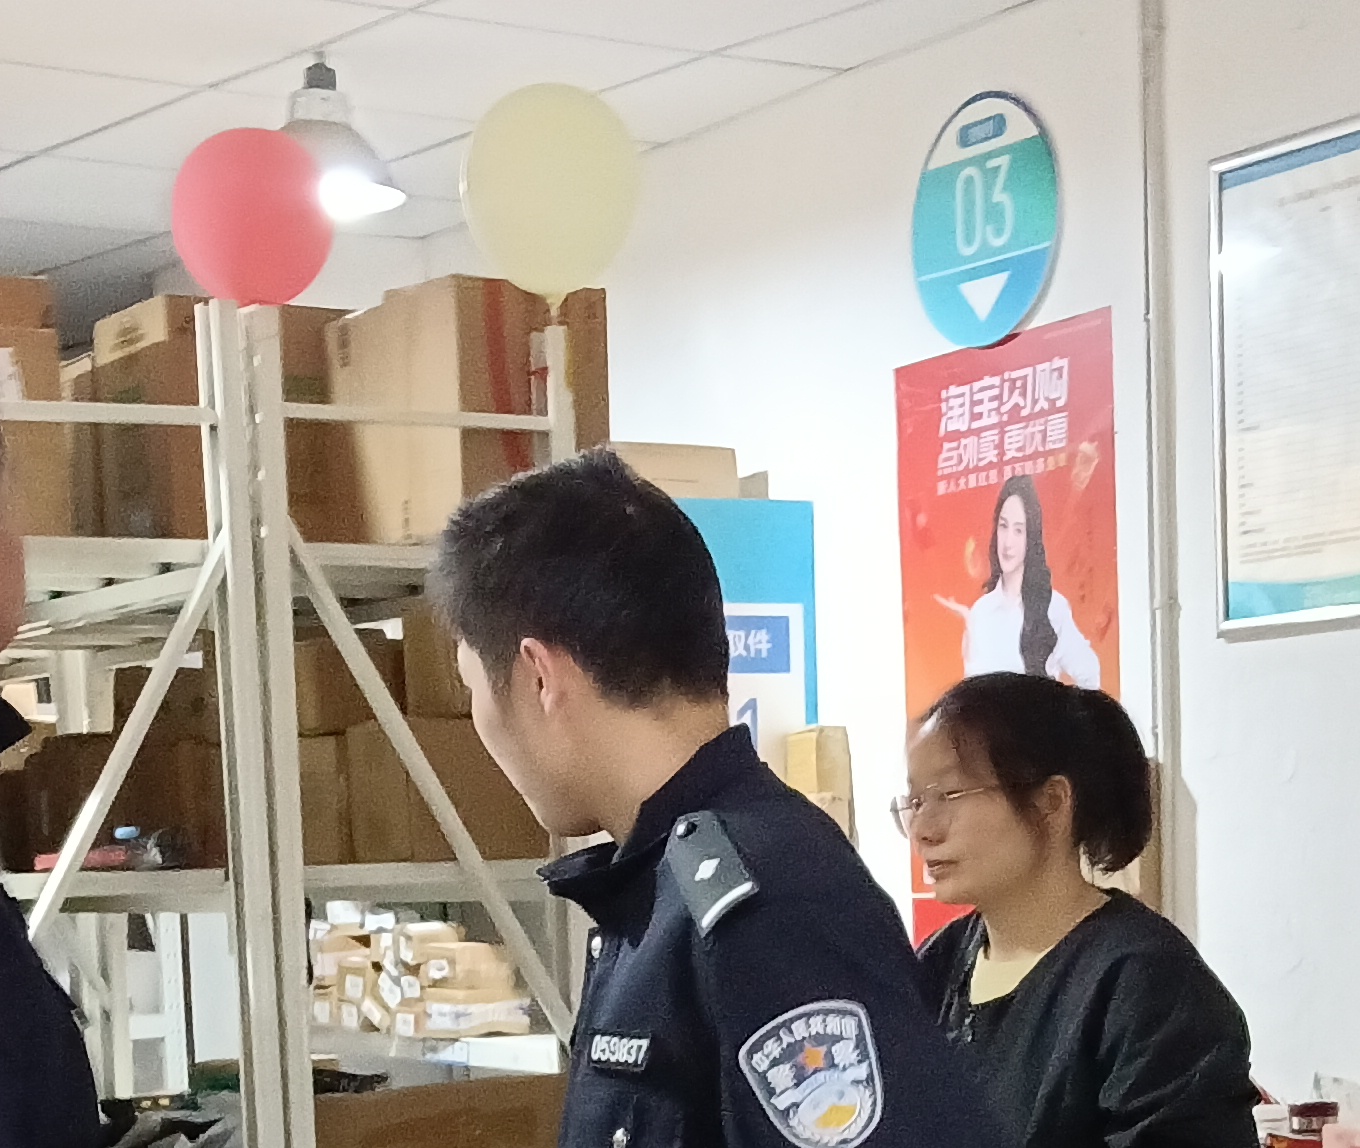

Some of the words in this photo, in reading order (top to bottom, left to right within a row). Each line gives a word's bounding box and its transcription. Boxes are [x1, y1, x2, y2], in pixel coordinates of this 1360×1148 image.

[955, 154, 1015, 256] 03
[938, 355, 1070, 438] 淘宝闪购
[937, 428, 1001, 477] 点外卖
[1003, 411, 1069, 462] 更优惠
